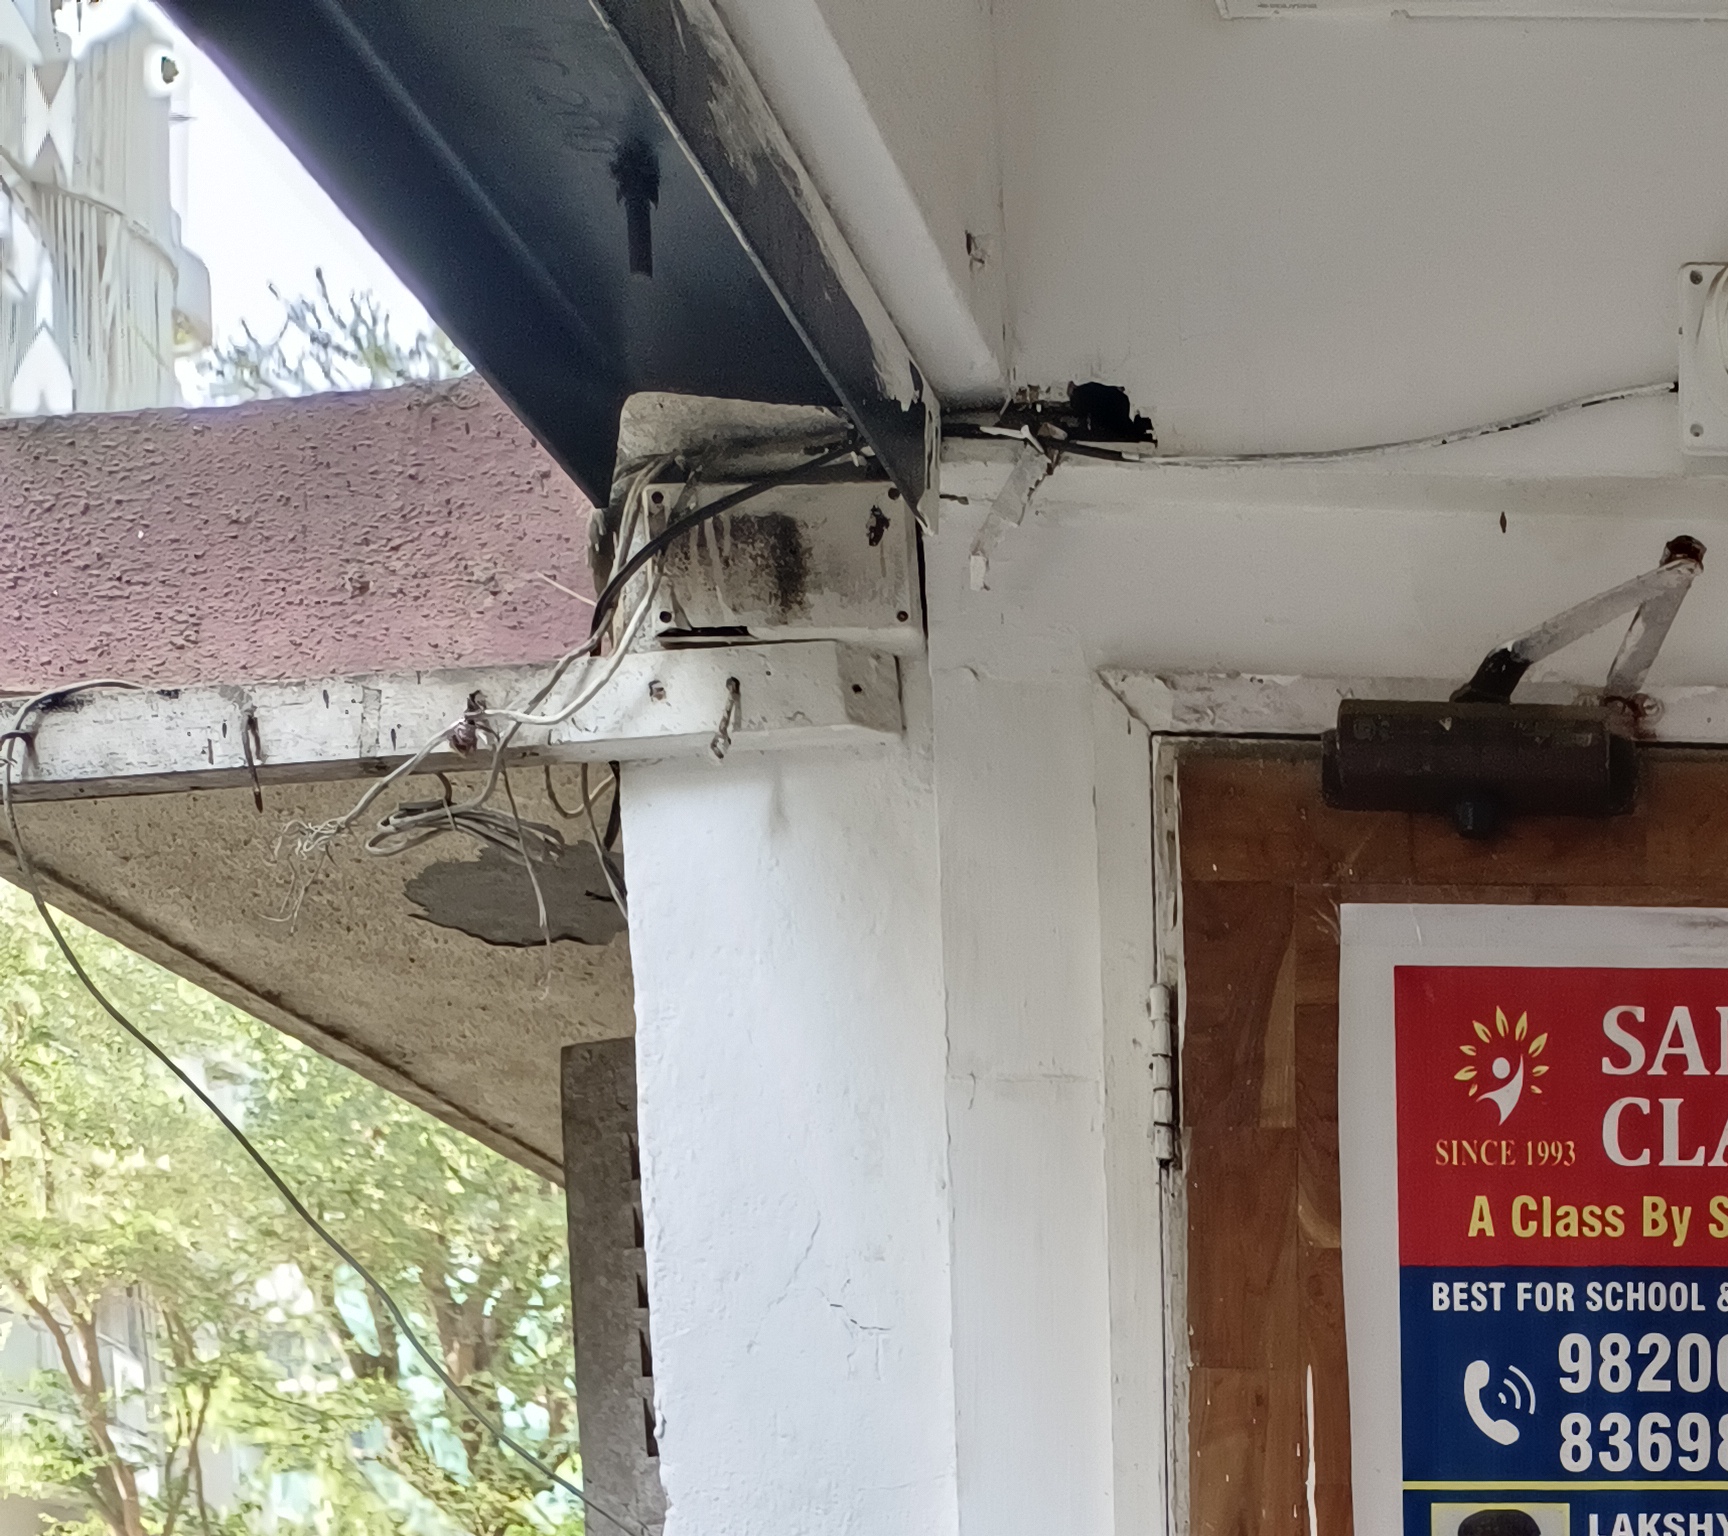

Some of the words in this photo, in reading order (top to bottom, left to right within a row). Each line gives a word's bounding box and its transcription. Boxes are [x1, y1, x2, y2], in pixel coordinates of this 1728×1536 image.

[1435, 1139, 1516, 1166] SINCE
[1527, 1140, 1576, 1167] 1993
[1467, 1195, 1496, 1238] A
[1511, 1194, 1625, 1238] Class
[1642, 1195, 1692, 1248] By
[1432, 1281, 1506, 1312] BEST
[1516, 1281, 1575, 1313] FOR
[1585, 1281, 1706, 1312] SCHOOL
